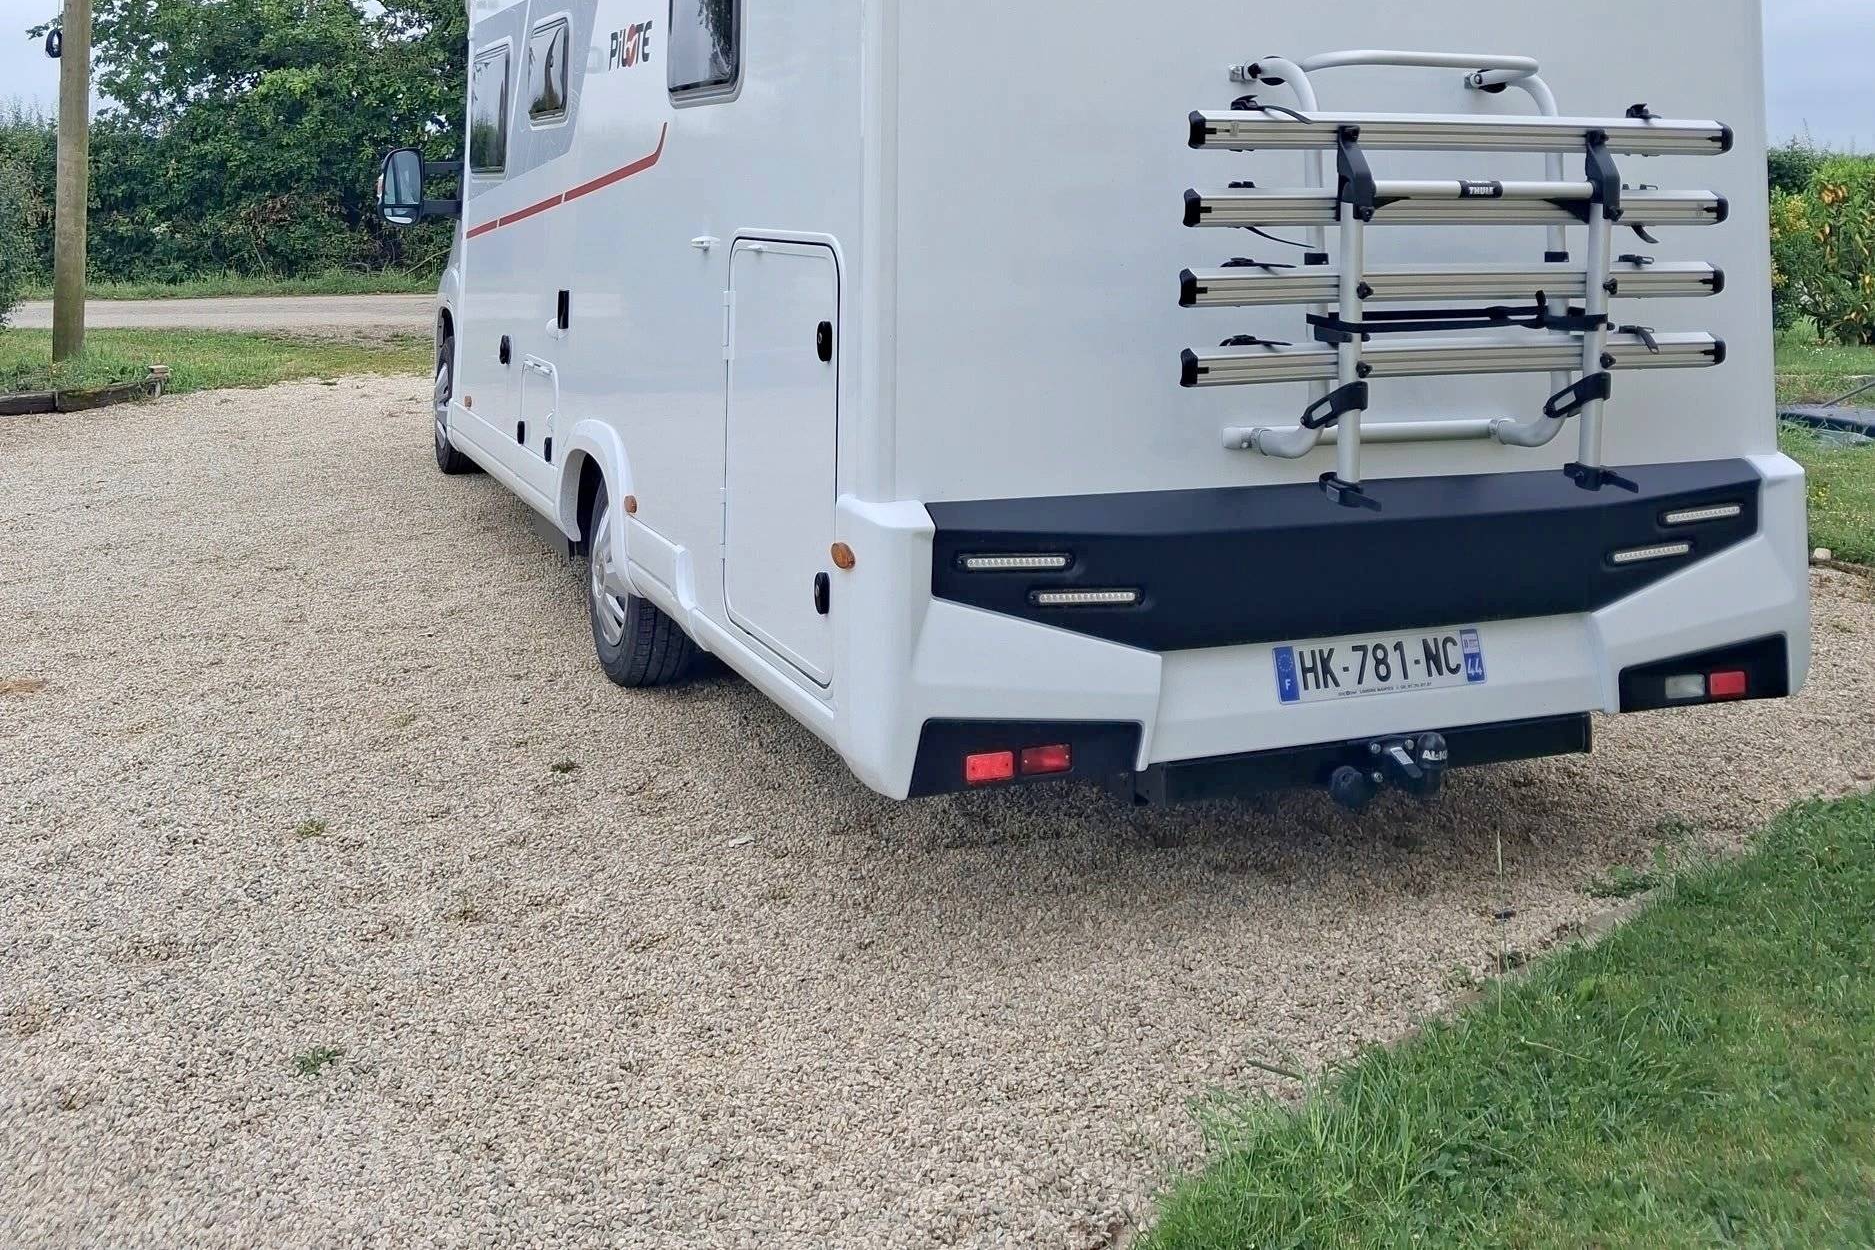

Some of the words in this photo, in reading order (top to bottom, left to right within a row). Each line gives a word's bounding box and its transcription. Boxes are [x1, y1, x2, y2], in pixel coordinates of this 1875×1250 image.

[1469, 186, 1494, 195] THULE
[1284, 678, 1291, 691] F
[1299, 636, 1462, 691] HK-781-NC
[1467, 657, 1483, 676] 44
